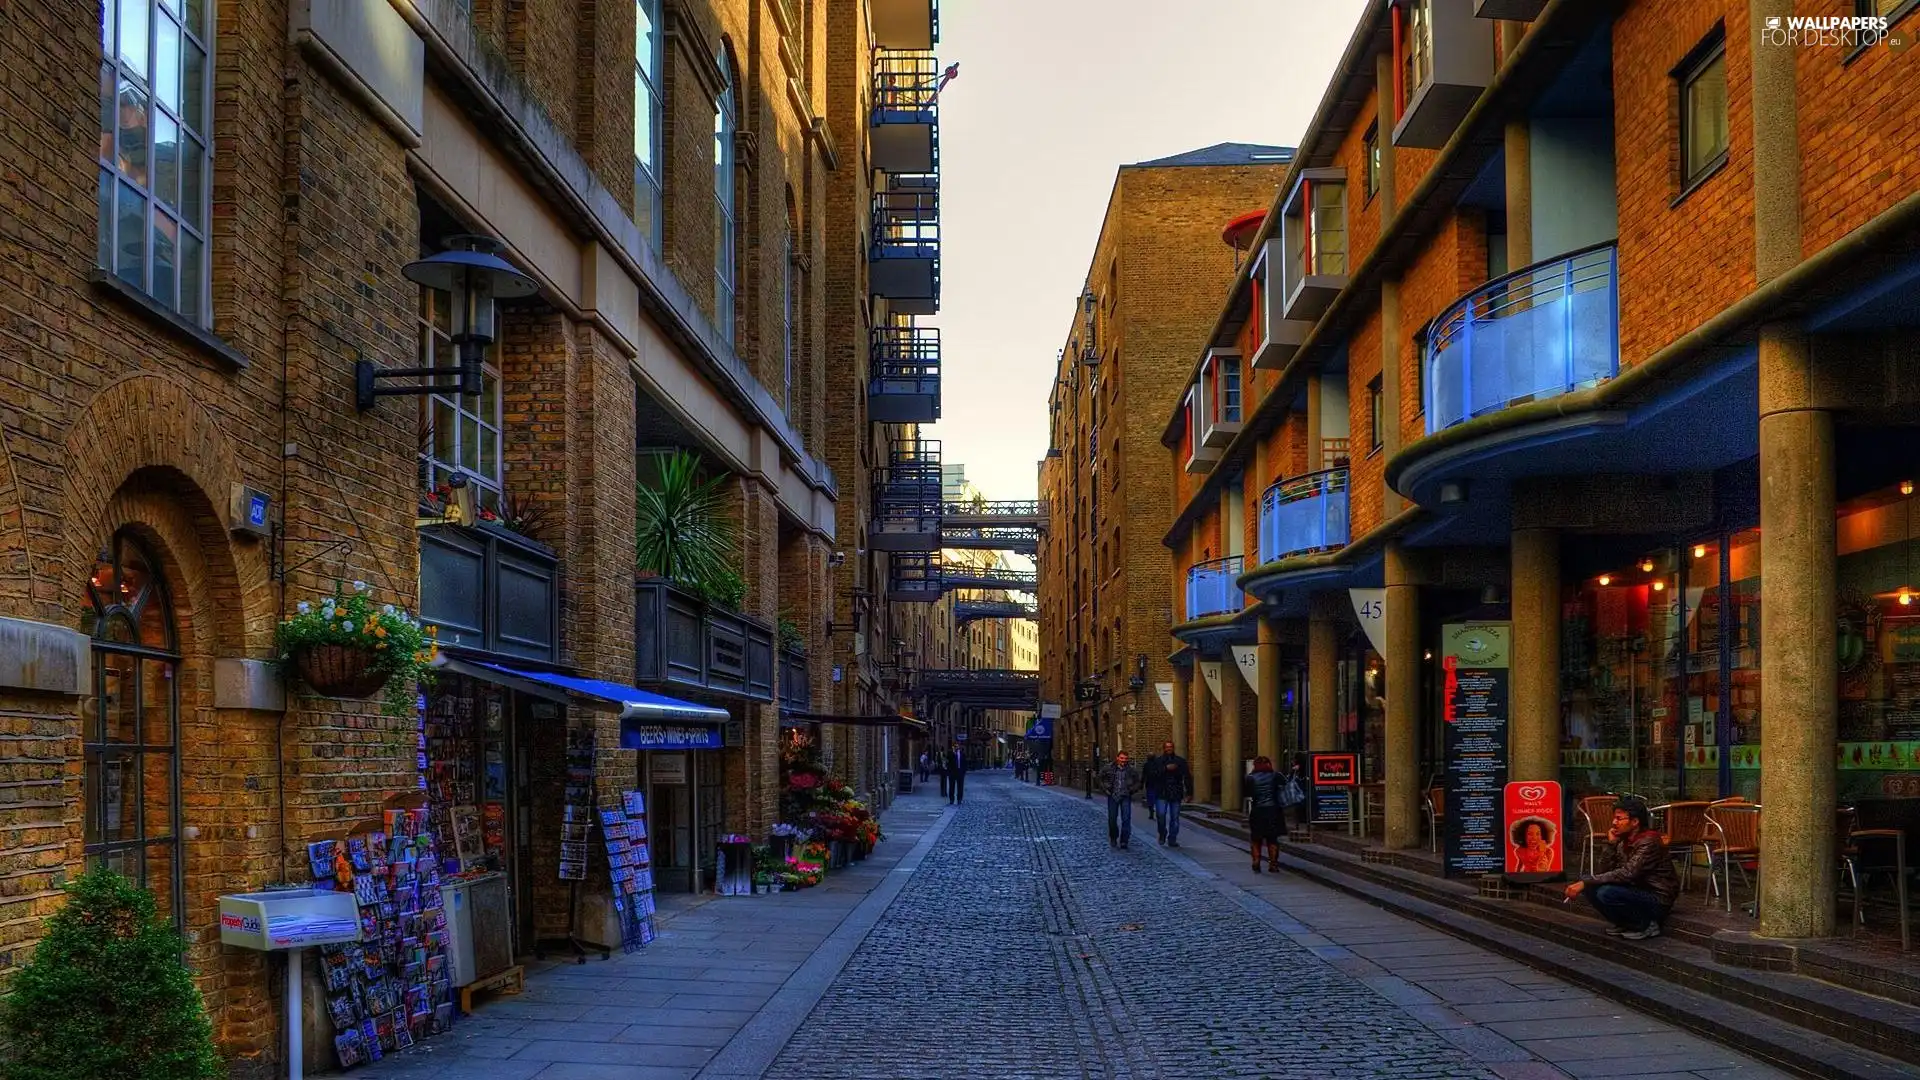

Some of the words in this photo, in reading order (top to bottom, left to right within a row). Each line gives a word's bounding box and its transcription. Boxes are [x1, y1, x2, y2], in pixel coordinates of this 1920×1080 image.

[1360, 600, 1382, 619] 45
[1240, 653, 1256, 667] 43
[1207, 669, 1218, 681] 41
[1082, 687, 1096, 698] 37
[640, 725, 665, 745] BEERS
